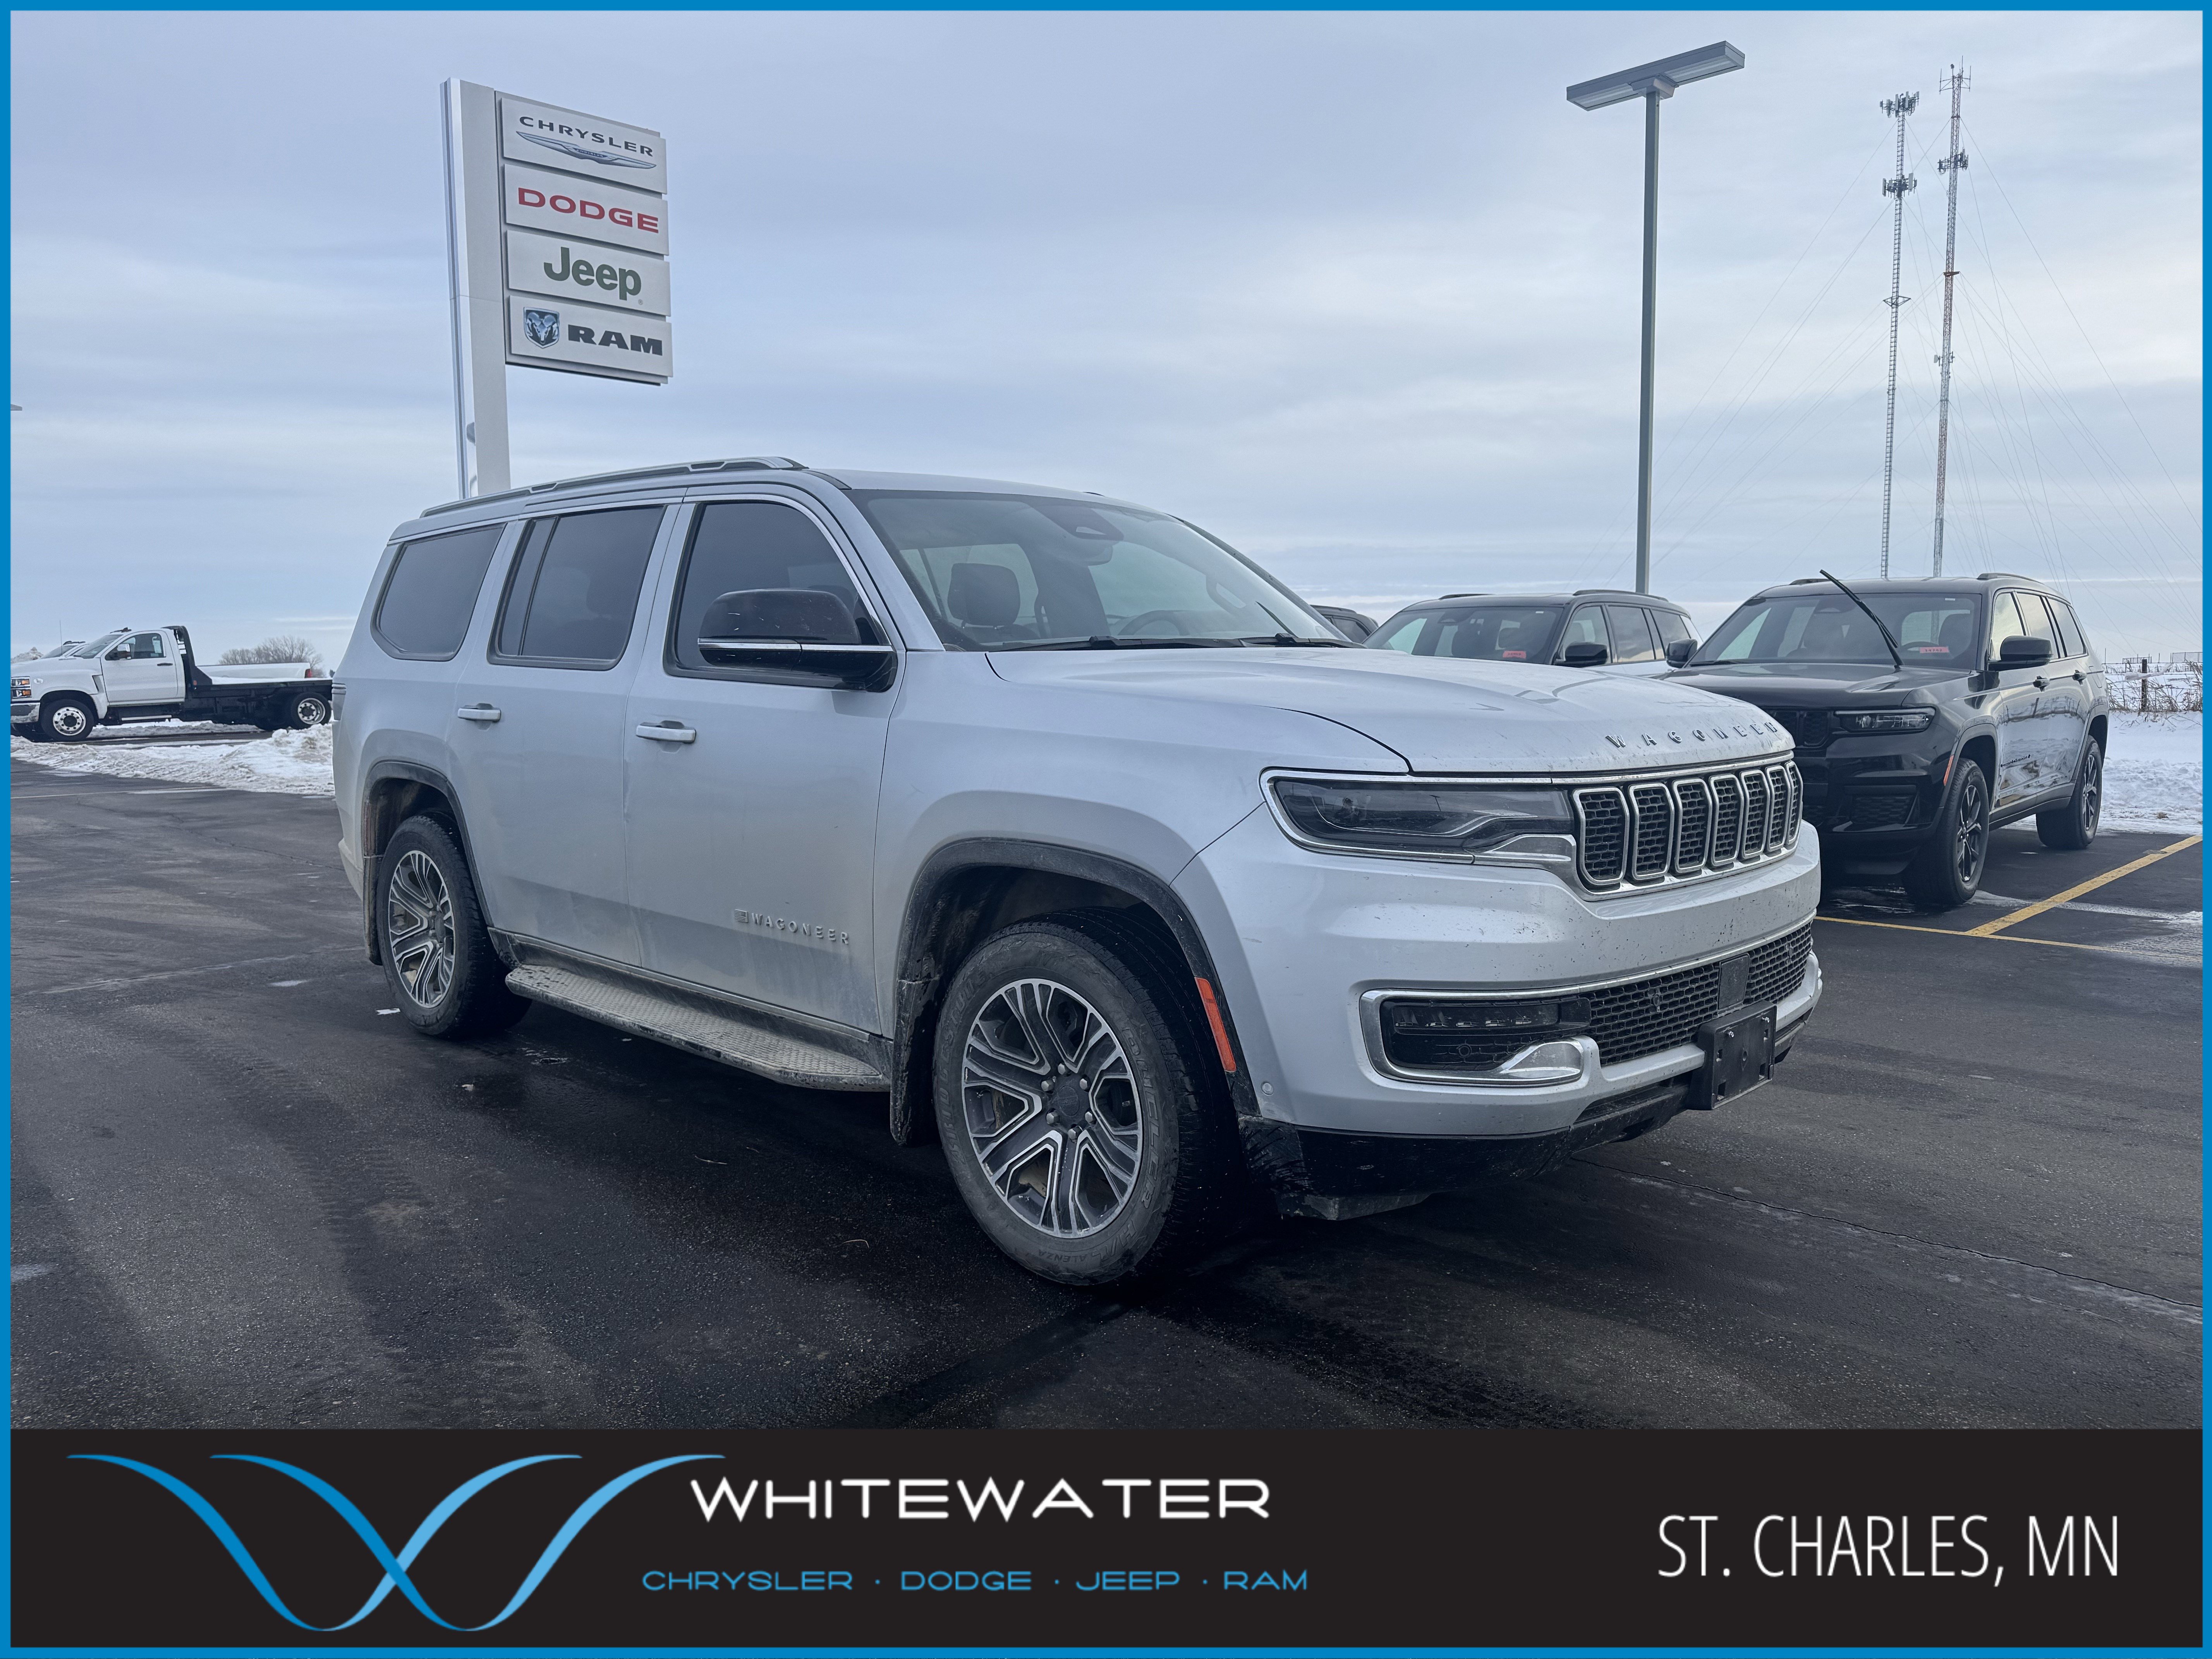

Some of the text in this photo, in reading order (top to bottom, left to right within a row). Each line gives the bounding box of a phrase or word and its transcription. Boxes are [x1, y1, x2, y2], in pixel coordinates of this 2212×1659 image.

[520, 116, 653, 157] CHRYSLER
[518, 187, 659, 233] DODGE
[543, 247, 642, 301] Jeep
[568, 324, 663, 356] RAM
[1605, 721, 1778, 748] WAGONEER
[751, 912, 849, 945] WAGONEER
